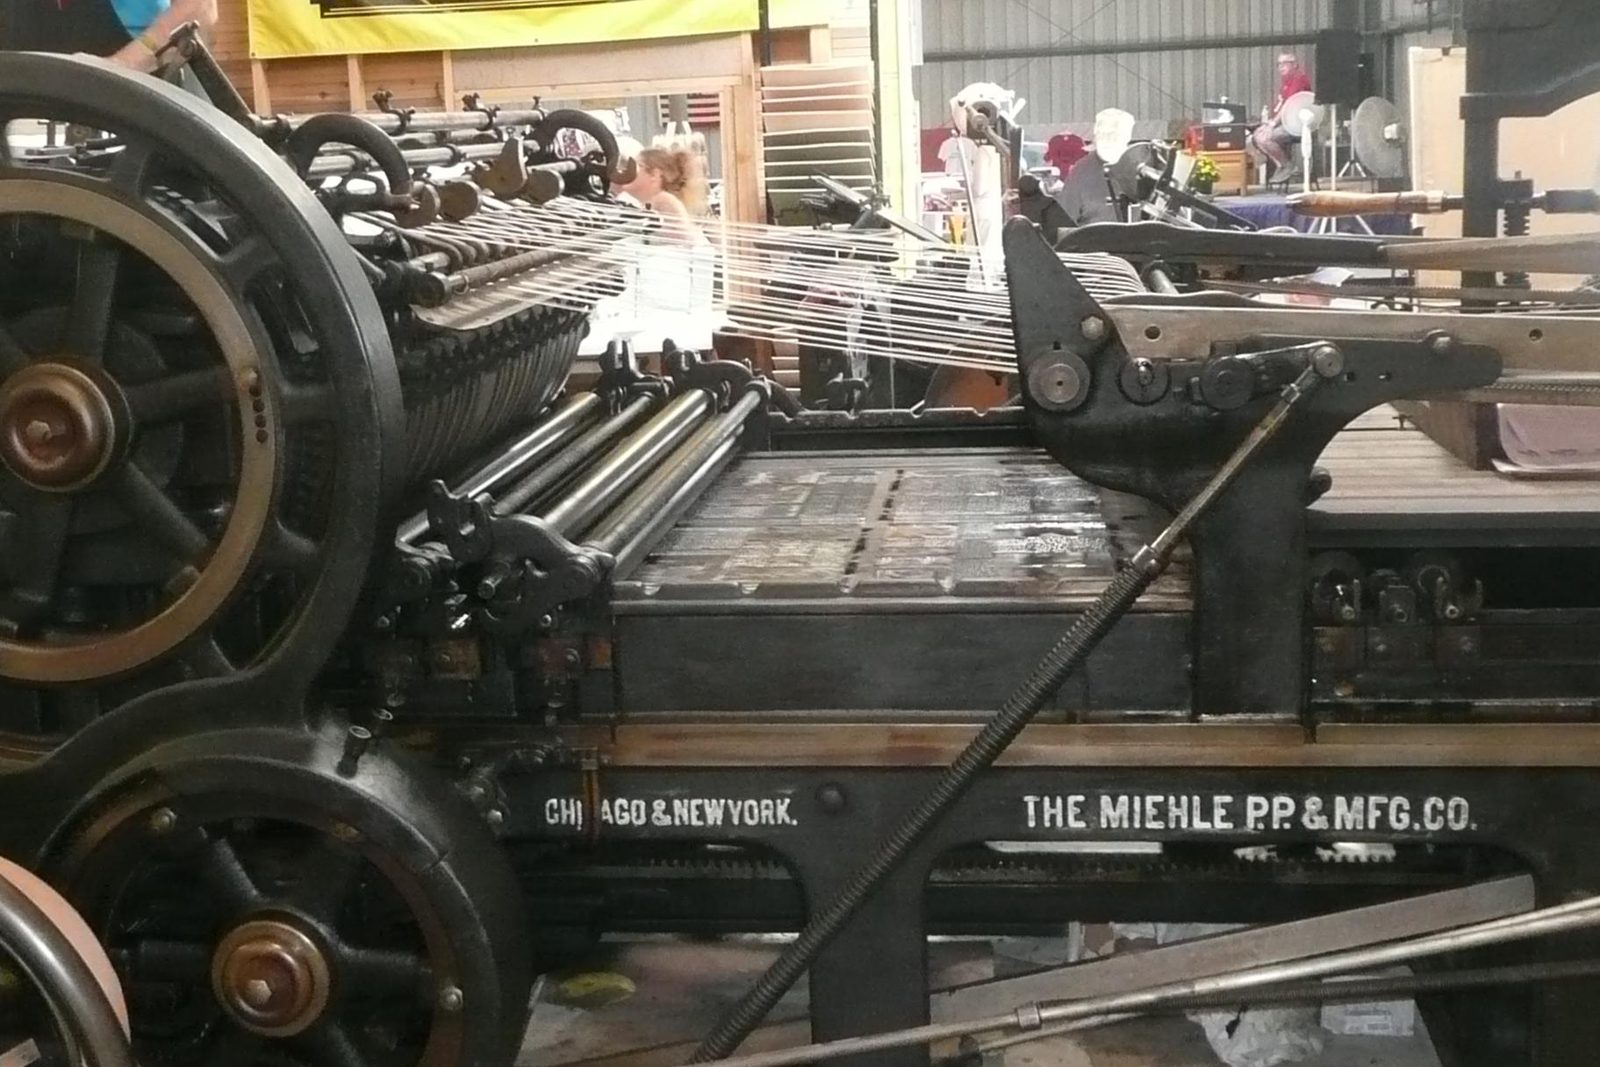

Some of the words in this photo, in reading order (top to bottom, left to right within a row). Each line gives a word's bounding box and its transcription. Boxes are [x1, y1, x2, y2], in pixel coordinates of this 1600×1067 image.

[545, 798, 647, 830] CHIAGO
[651, 799, 672, 826] &
[1023, 795, 1087, 828] THE
[1100, 795, 1234, 829] MIEHLE
[1302, 797, 1329, 830] &
